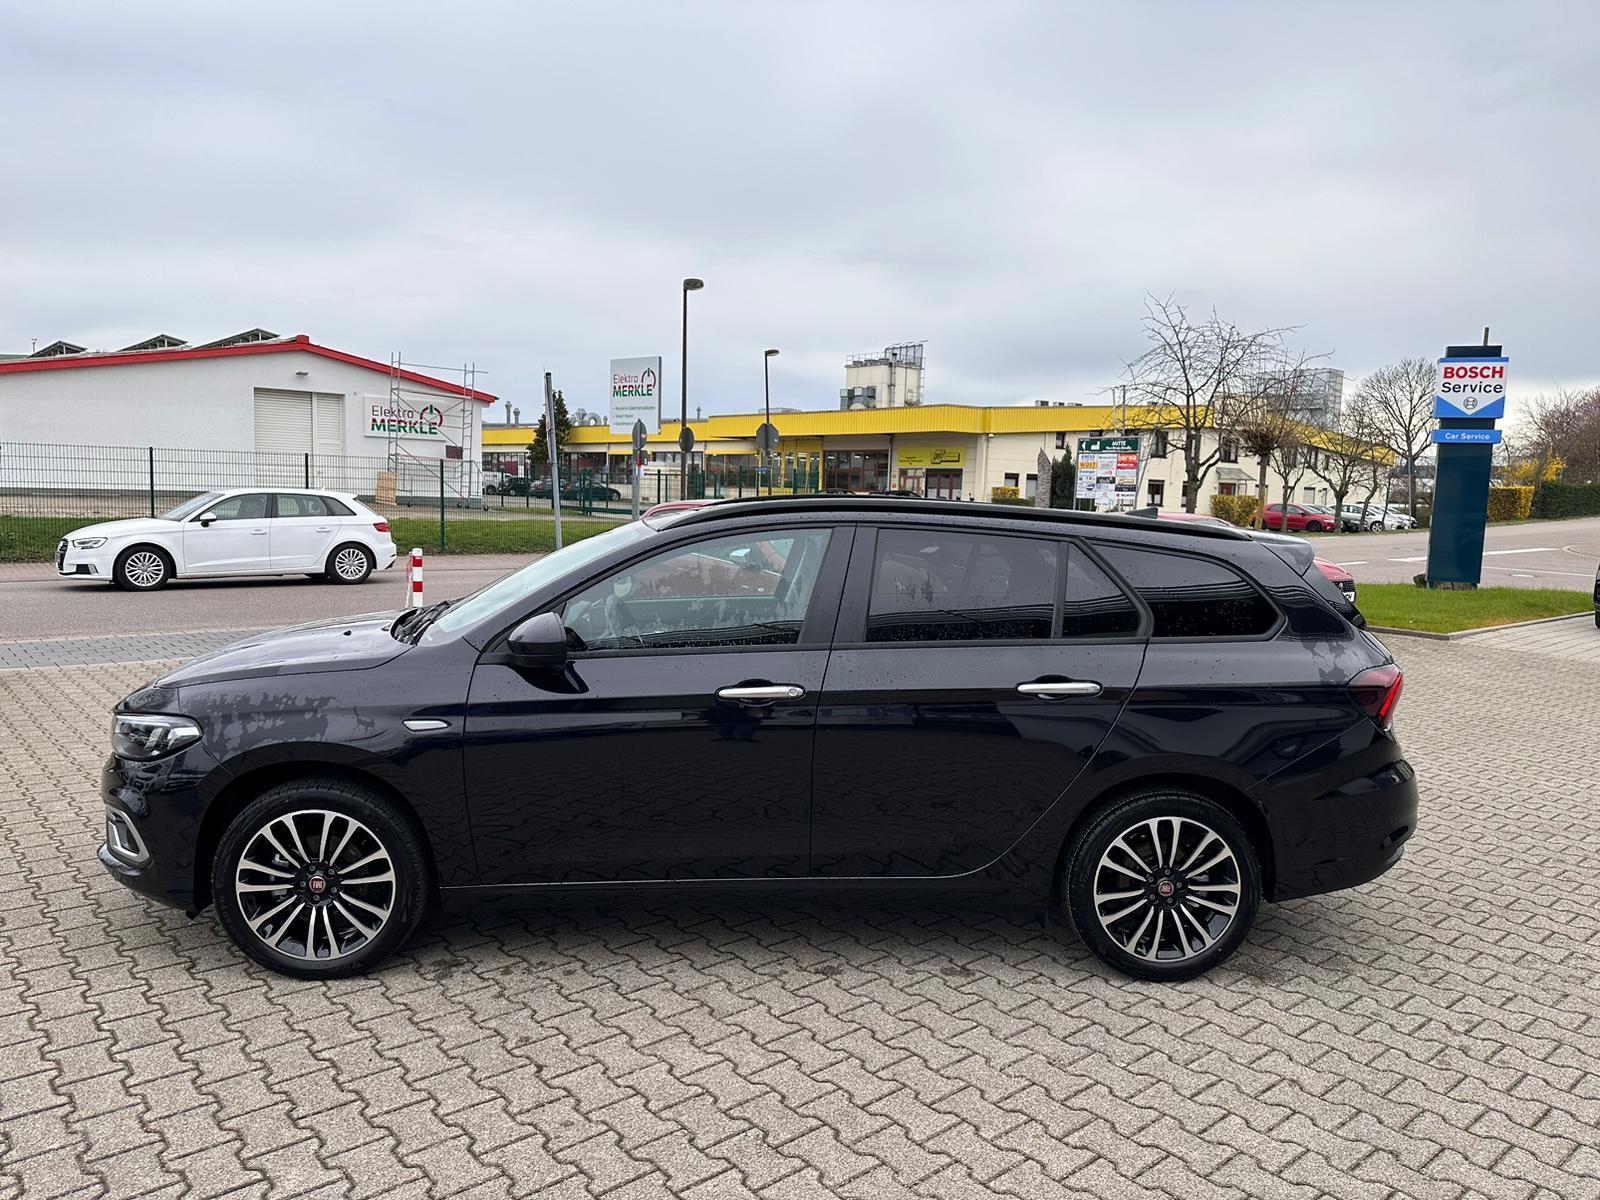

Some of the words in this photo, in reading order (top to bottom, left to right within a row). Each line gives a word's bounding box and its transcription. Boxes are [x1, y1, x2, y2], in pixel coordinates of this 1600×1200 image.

[613, 374, 639, 384] Elektro
[1443, 366, 1504, 379] BOSCH
[612, 384, 653, 397] MERKLE
[1441, 381, 1503, 393] Service
[371, 405, 414, 419] Elektro
[371, 418, 438, 435] MERKLE
[1445, 432, 1459, 440] Car
[1460, 432, 1490, 440] Service
